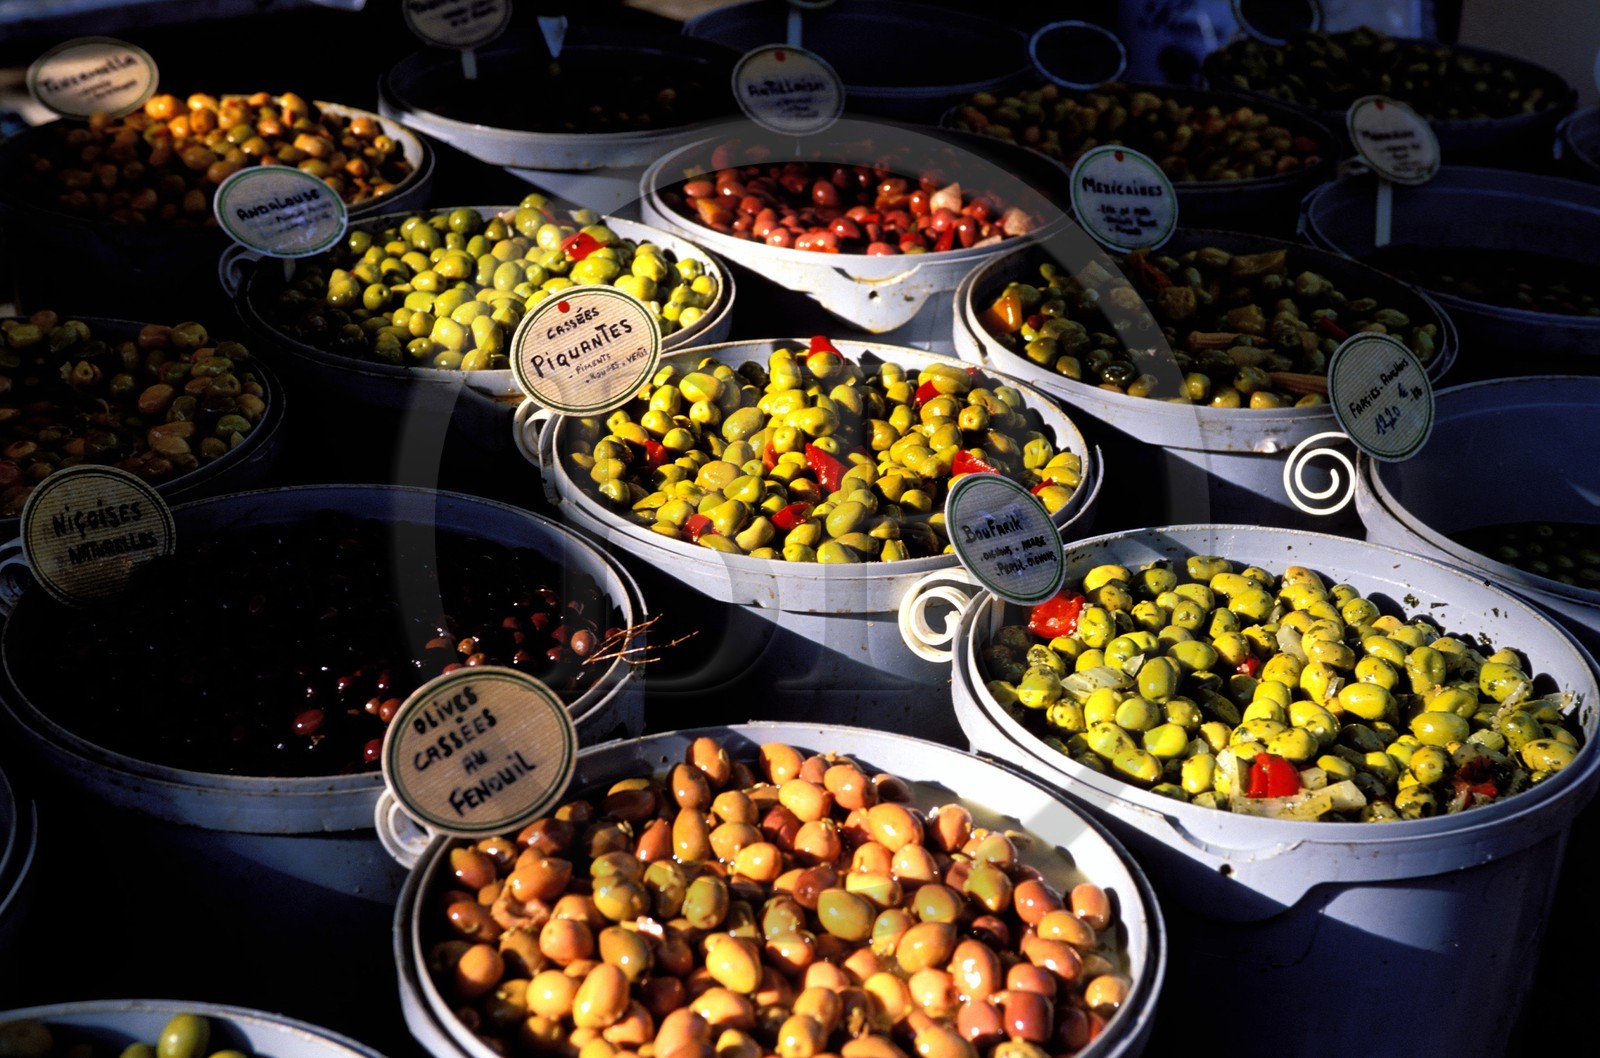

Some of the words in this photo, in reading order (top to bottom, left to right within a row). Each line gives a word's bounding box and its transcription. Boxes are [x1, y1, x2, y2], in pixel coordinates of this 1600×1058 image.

[236, 188, 320, 221] ANDALOUSE
[531, 319, 633, 379] PIQUANTES
[52, 498, 142, 538] NIÇOISES
[413, 686, 479, 735] OLIVES
[448, 751, 537, 817] FENOUIL
[462, 750, 489, 775] AU
